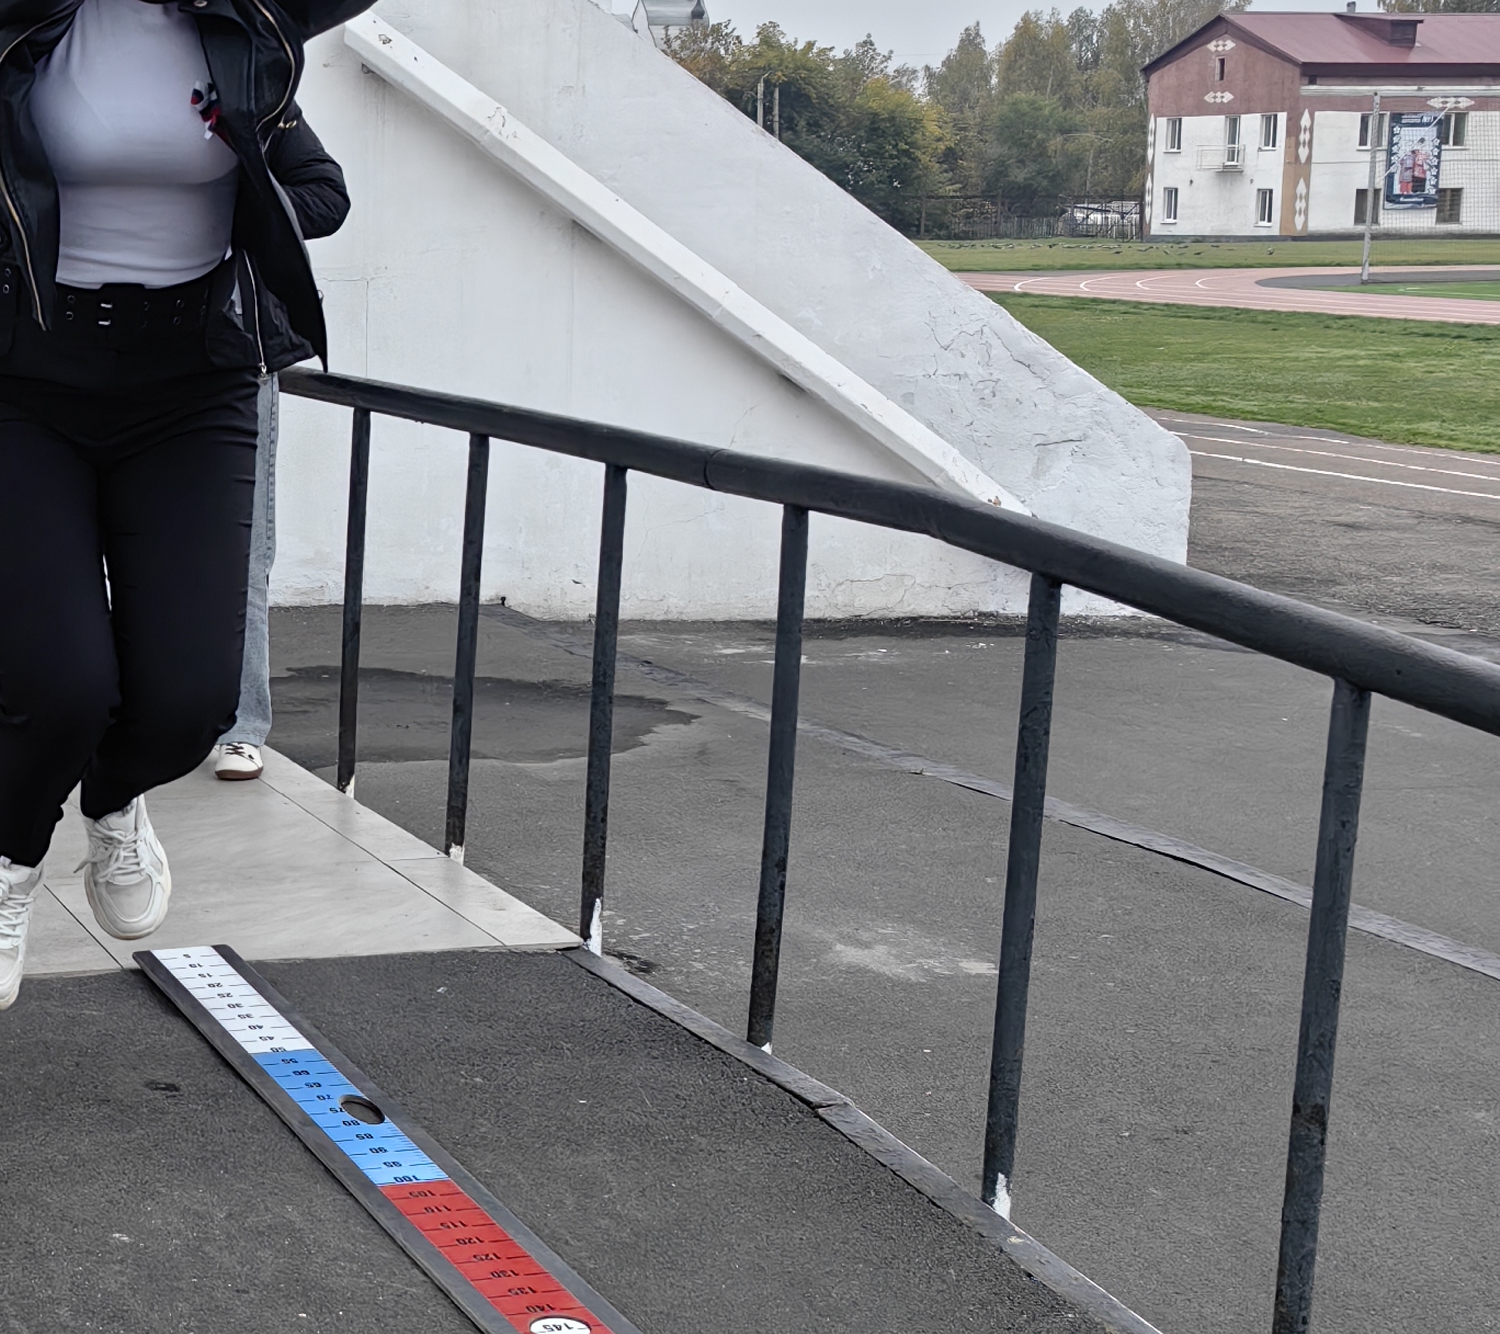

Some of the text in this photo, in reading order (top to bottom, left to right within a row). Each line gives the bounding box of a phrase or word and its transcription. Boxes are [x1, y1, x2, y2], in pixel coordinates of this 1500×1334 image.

[394, 1175, 421, 1183] 100
[409, 1190, 436, 1198] 105
[424, 1205, 451, 1214] 110
[440, 1221, 468, 1230] 115
[456, 1237, 485, 1245] 120
[473, 1253, 501, 1262] 125
[490, 1270, 520, 1278] 130
[508, 1286, 538, 1296] 135
[526, 1304, 556, 1313] 140
[542, 1323, 574, 1332] 145
